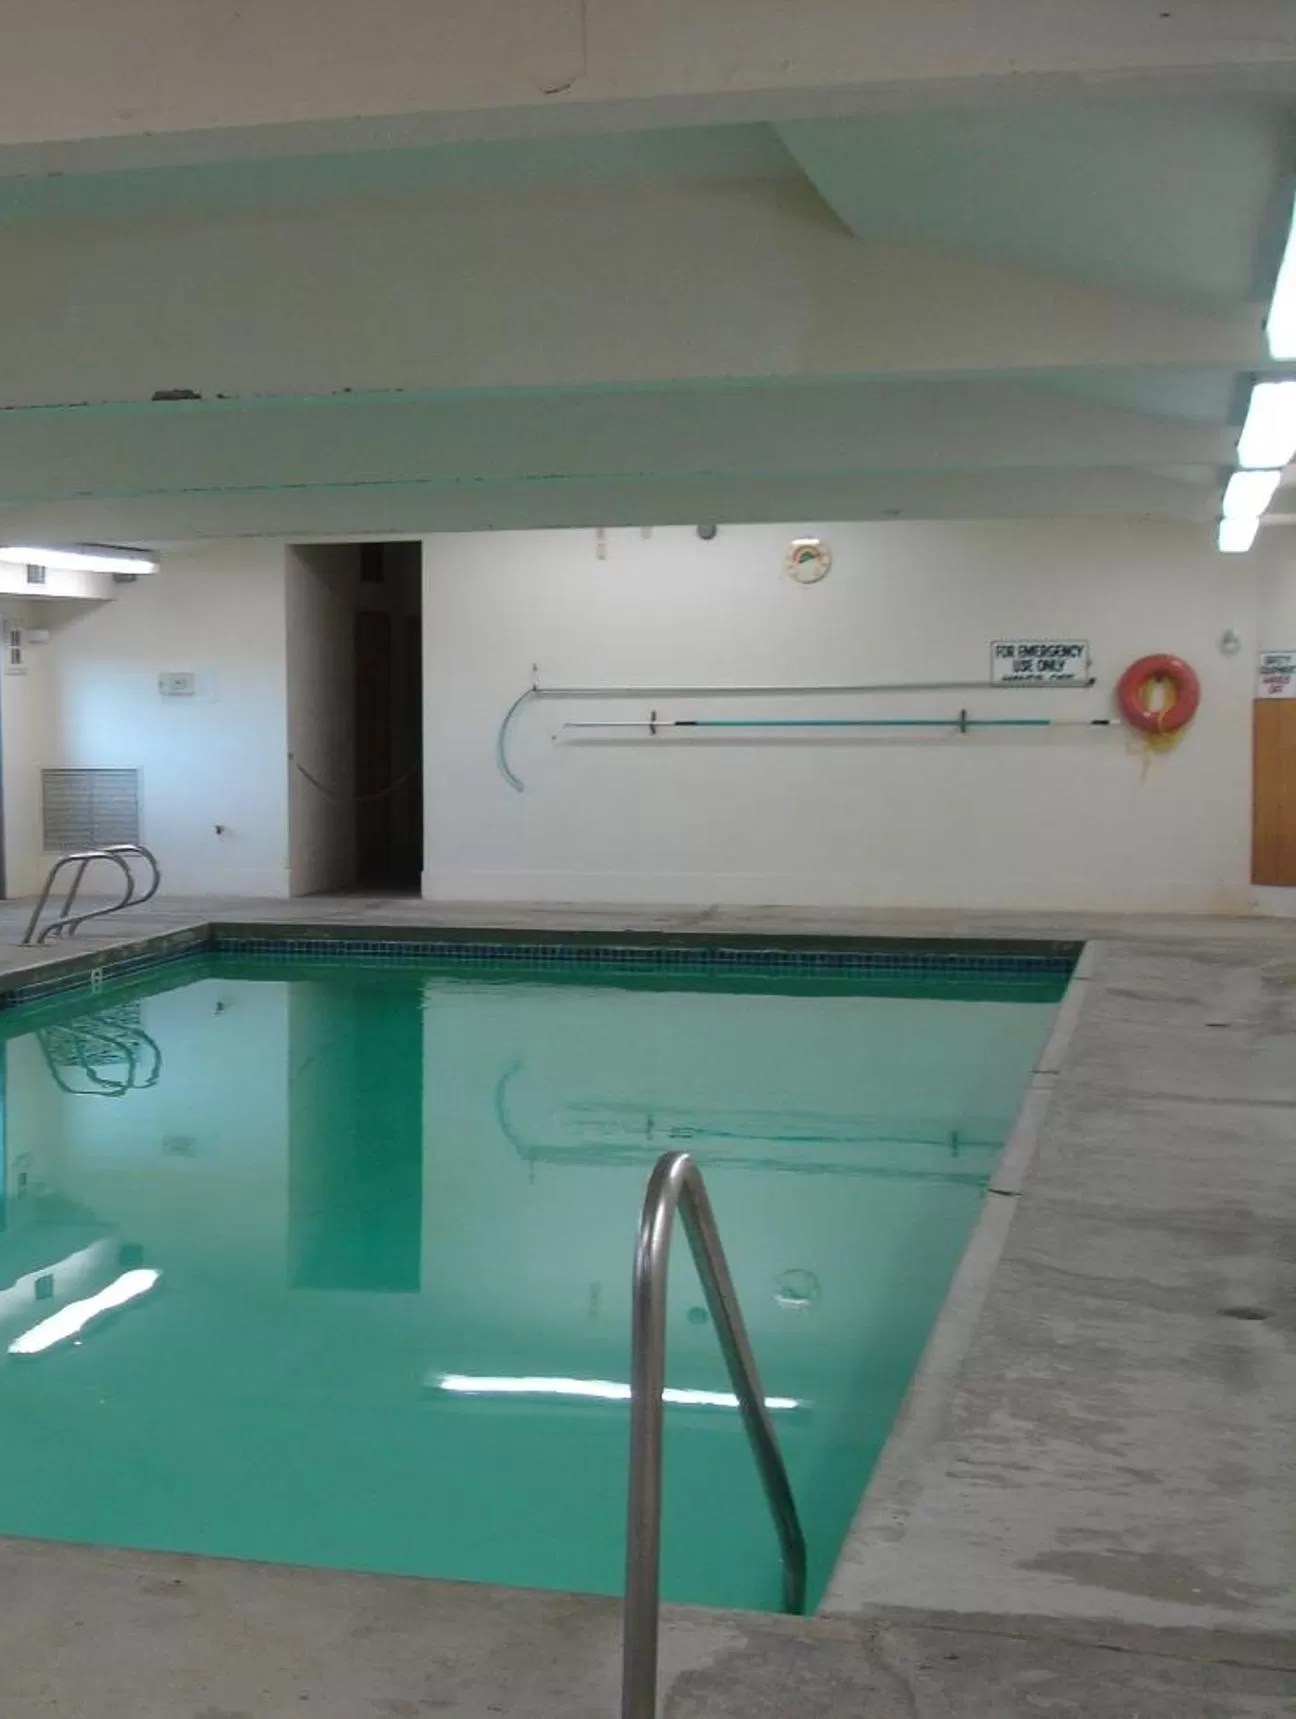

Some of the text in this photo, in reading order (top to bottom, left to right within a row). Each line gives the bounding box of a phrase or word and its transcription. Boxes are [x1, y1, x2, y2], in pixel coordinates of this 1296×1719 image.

[995, 644, 1085, 658] FOR EMERGENCY
[1013, 659, 1066, 672] USE ONLY
